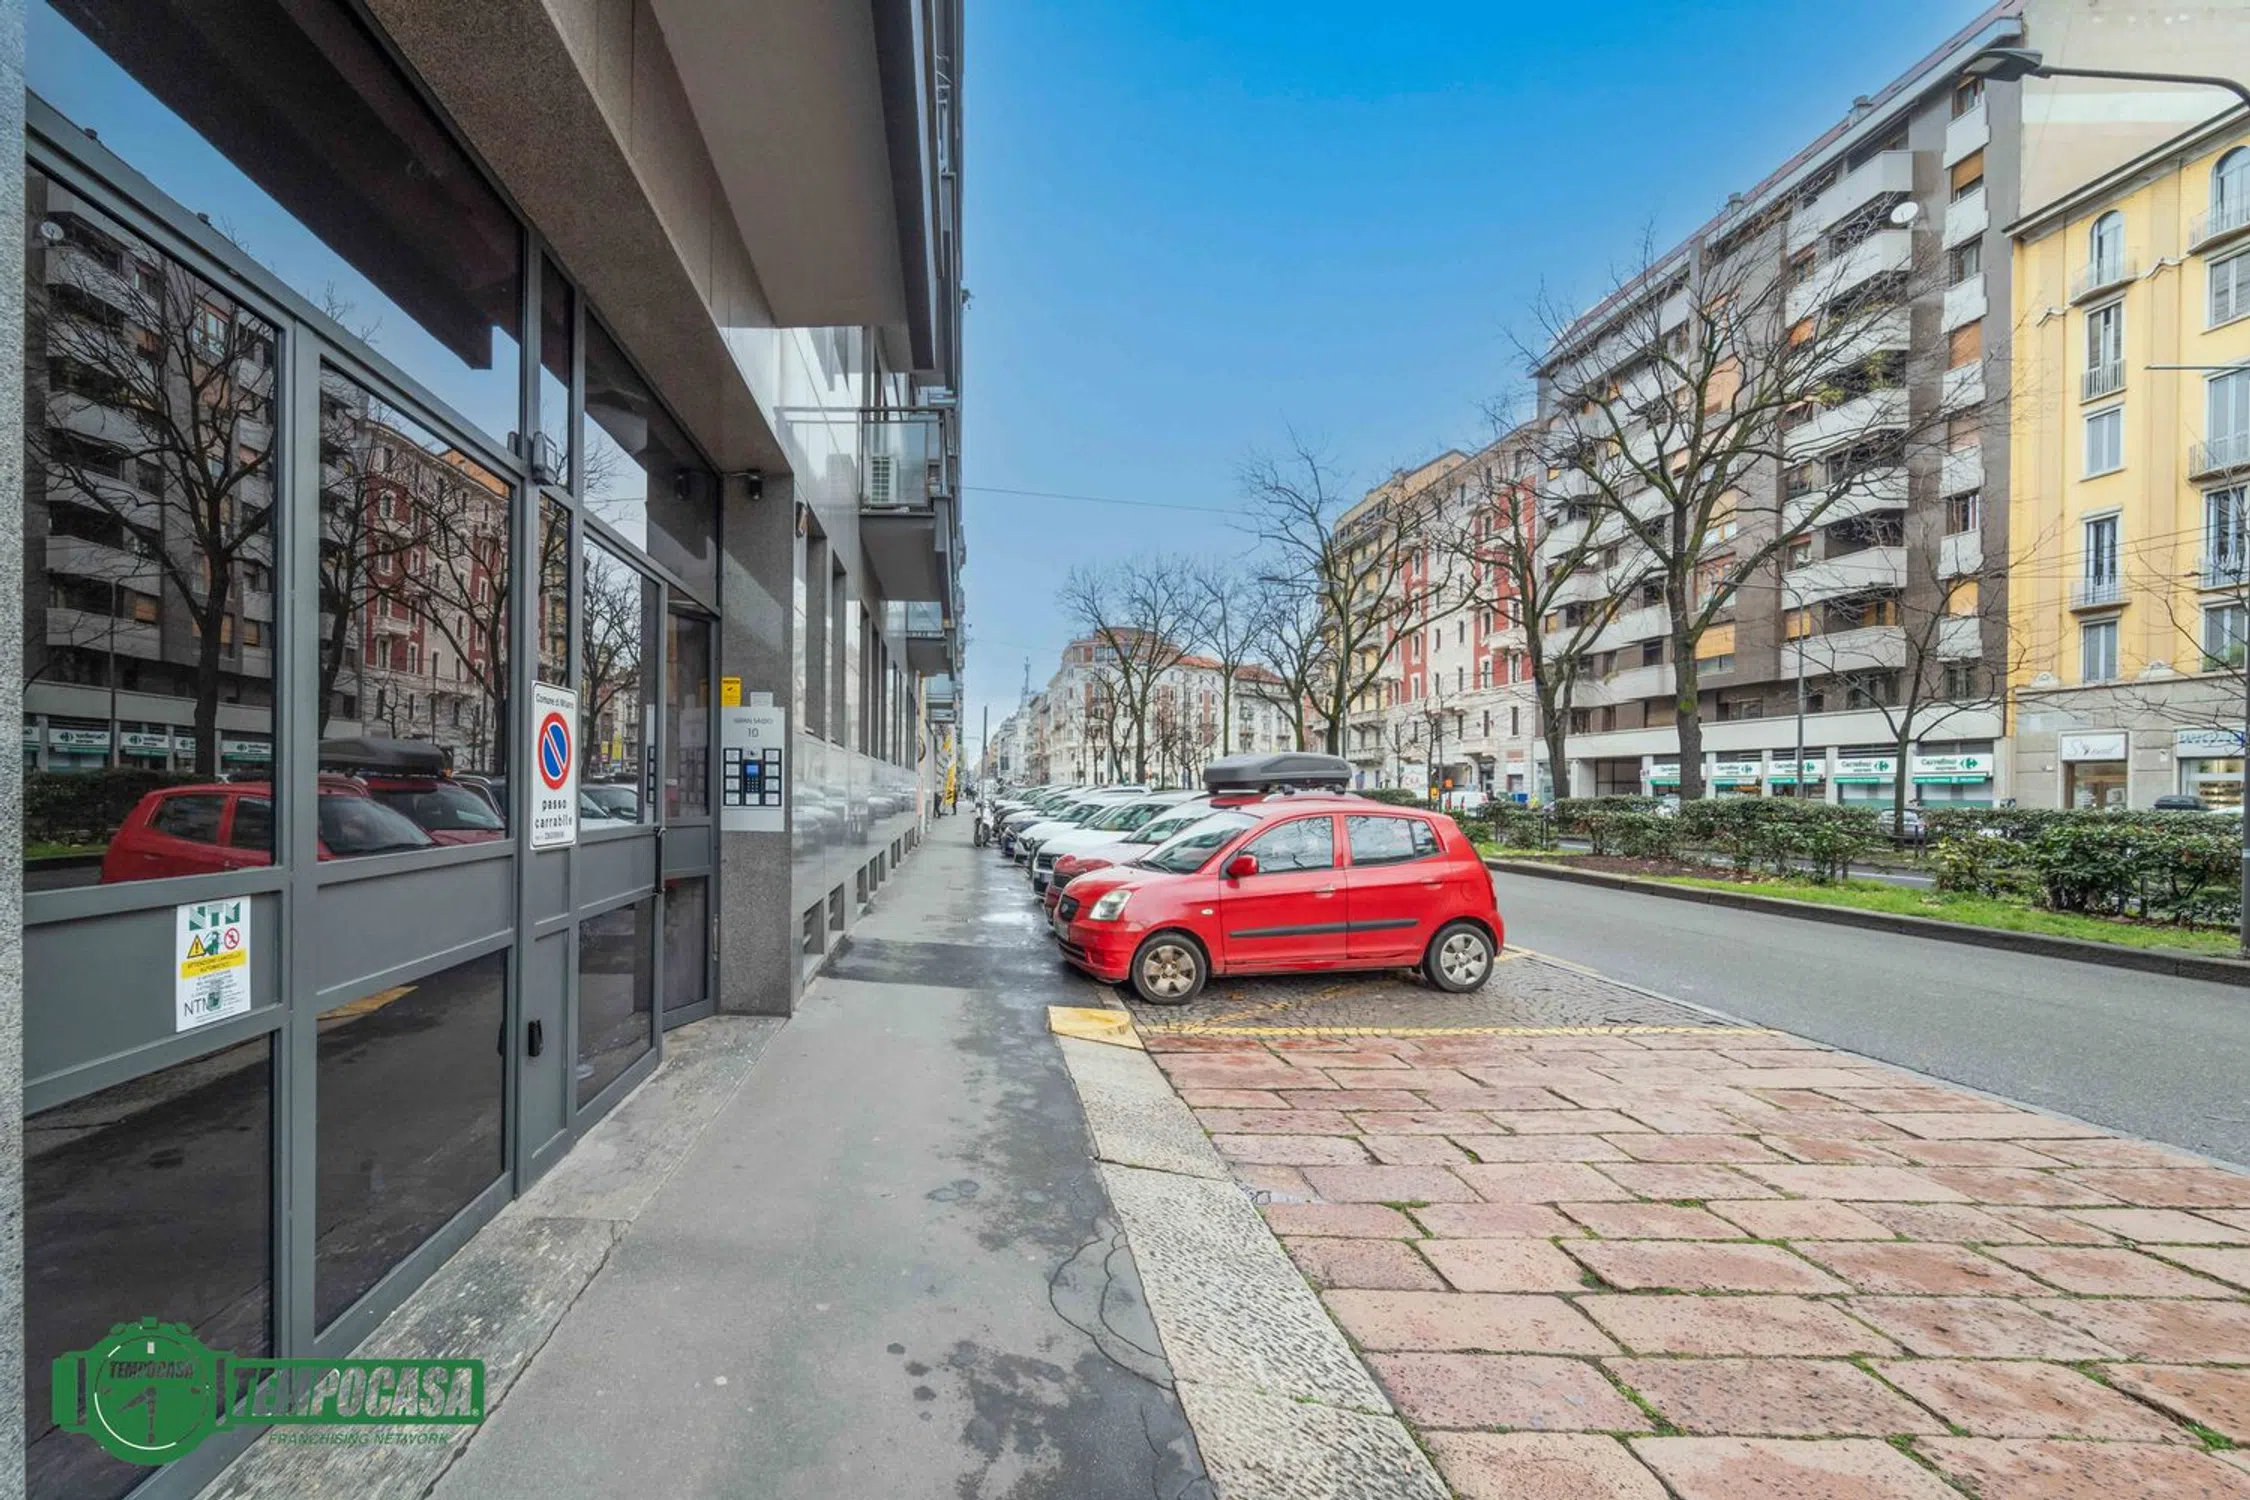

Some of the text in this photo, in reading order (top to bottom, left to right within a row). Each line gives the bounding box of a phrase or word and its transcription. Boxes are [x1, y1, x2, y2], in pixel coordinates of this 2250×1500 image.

[747, 727, 759, 738] 10
[542, 799, 567, 812] passo
[534, 814, 573, 829] carrabile
